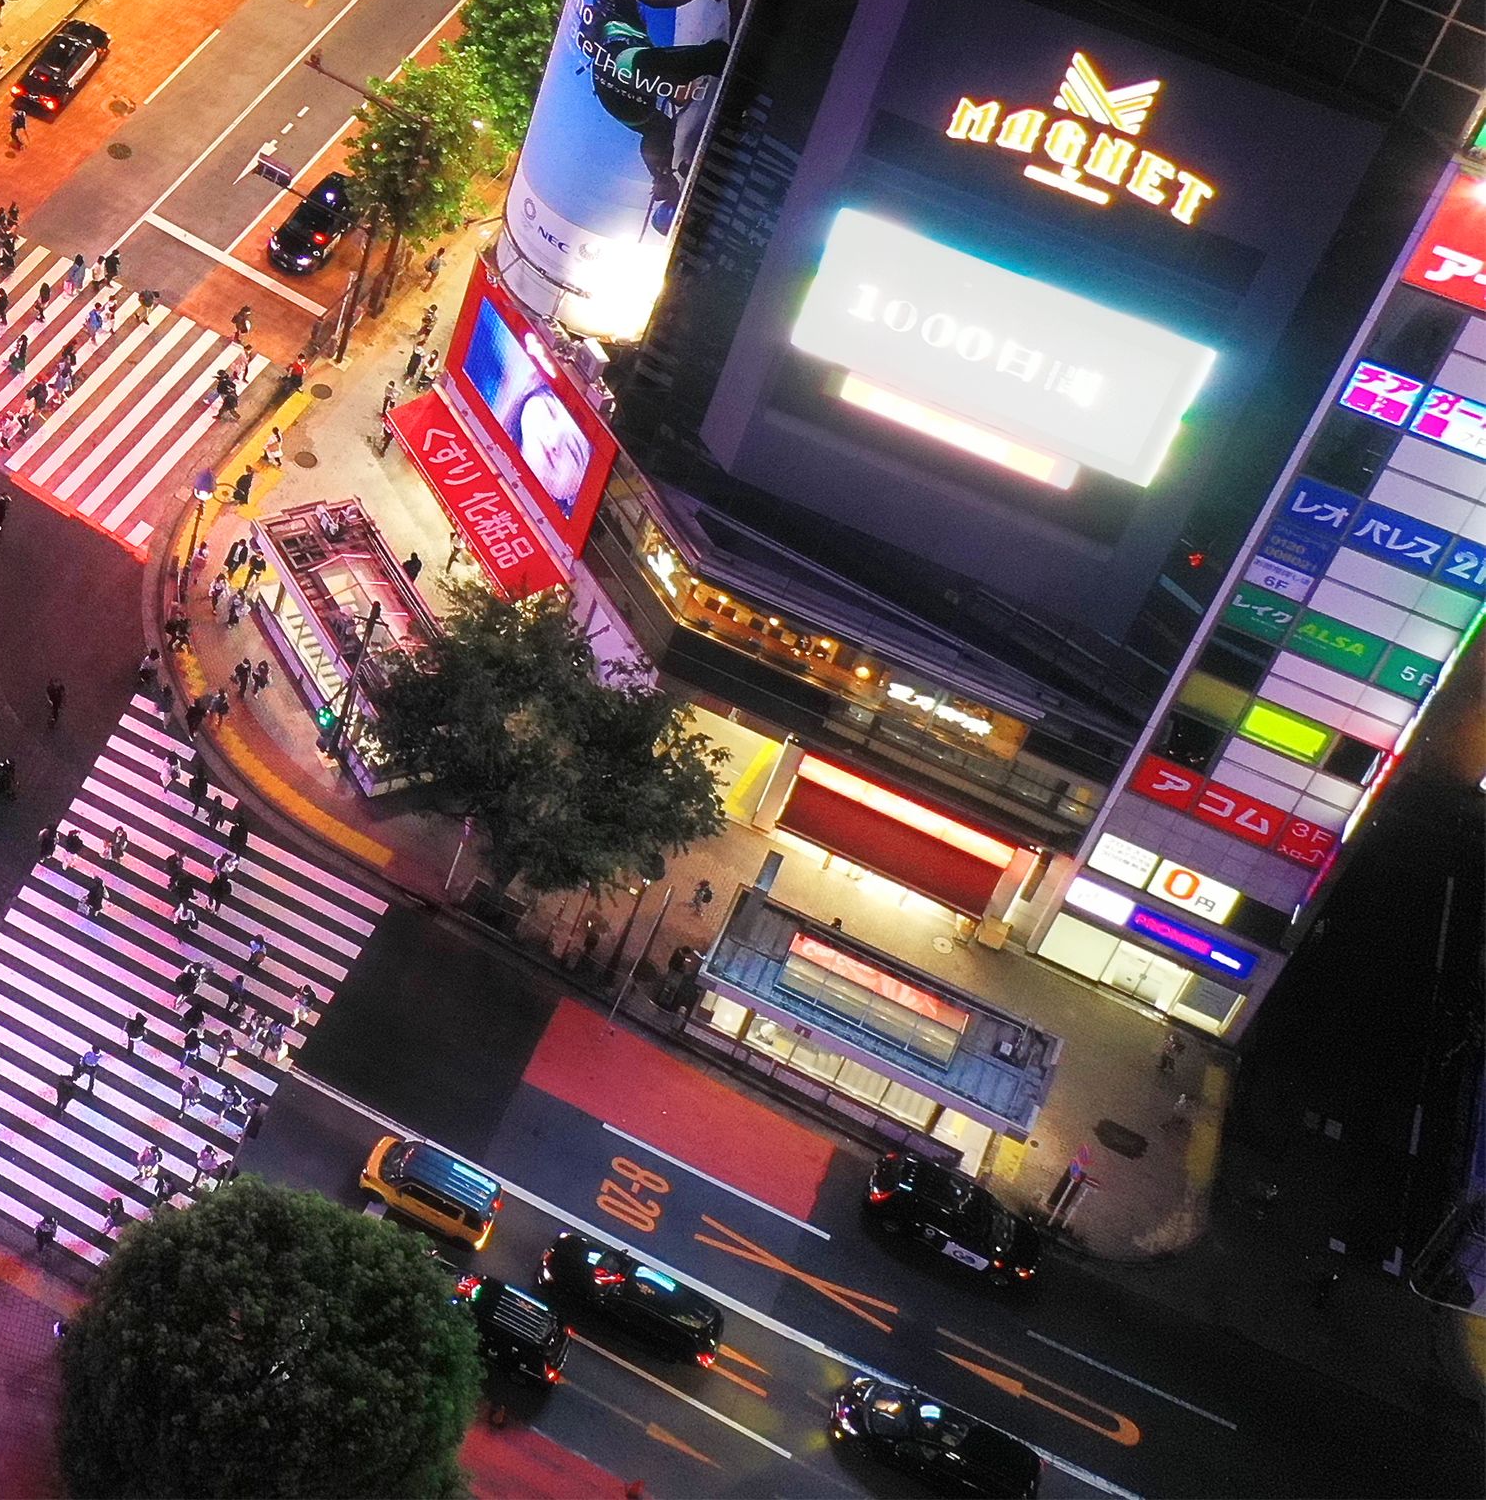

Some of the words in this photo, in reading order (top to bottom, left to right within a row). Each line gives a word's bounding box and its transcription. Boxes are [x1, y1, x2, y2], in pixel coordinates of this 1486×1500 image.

[946, 95, 1216, 227] MAGNET
[537, 224, 569, 256] NEC
[1428, 247, 1486, 286] ア
[849, 282, 1105, 408] 1000日
[1354, 366, 1486, 432] チアガー
[424, 428, 482, 487] くすり
[459, 490, 535, 570] 化粧品
[1262, 572, 1290, 594] 6F
[1233, 592, 1294, 627] レイク
[1298, 620, 1367, 660] ALSA
[1399, 663, 1436, 690] 5F
[1150, 768, 1275, 838] アコム
[1291, 820, 1334, 846] 3F
[1162, 867, 1217, 915] 0円
